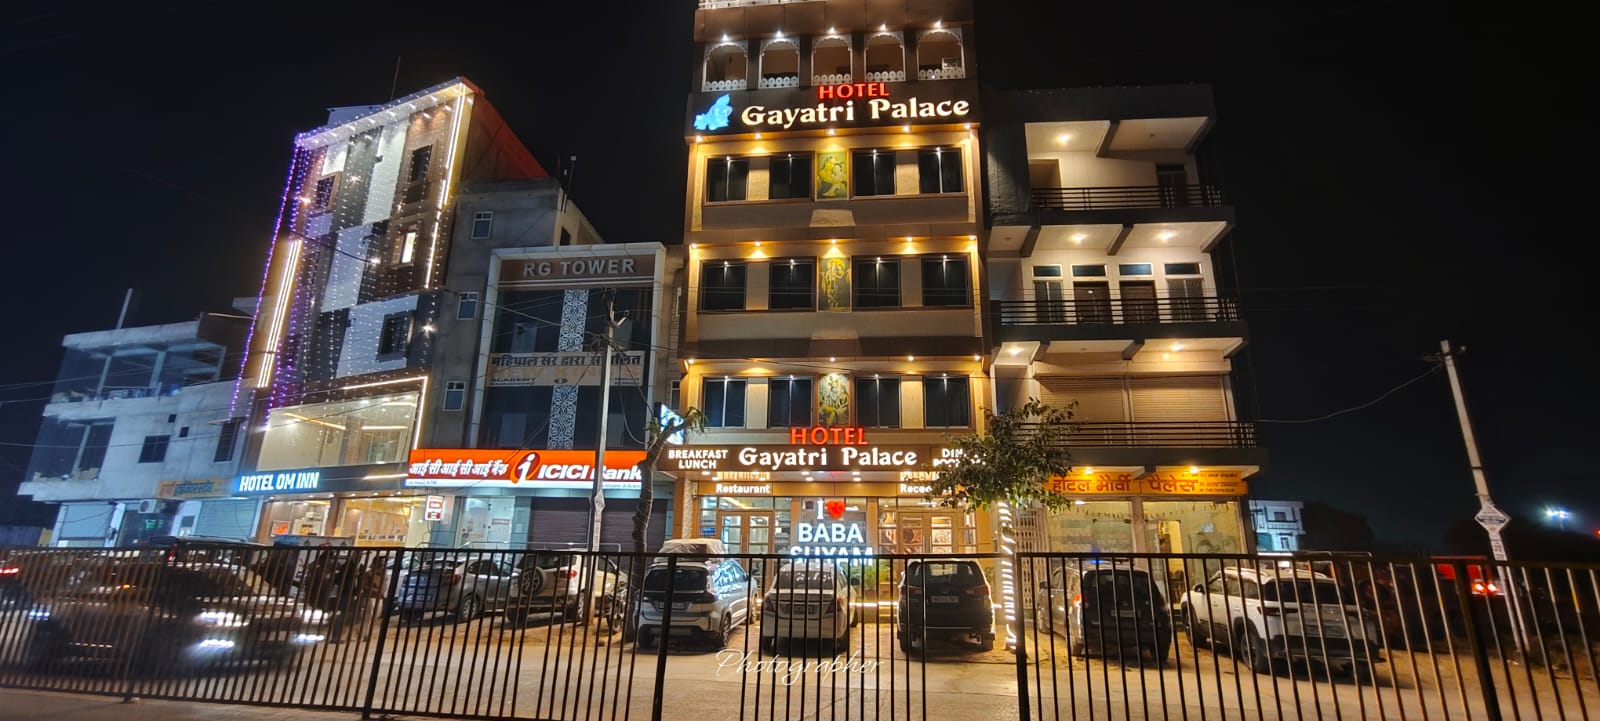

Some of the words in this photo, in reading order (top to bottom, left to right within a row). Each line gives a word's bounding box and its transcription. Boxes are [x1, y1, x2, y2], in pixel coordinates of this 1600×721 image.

[818, 82, 890, 99] HOTEL
[741, 100, 853, 129] Gayatri
[868, 97, 970, 119] Palace
[523, 262, 551, 277] RG
[561, 258, 635, 275] TOWER
[790, 426, 868, 446] HOTEL
[668, 449, 728, 460] BREAKFAST
[739, 447, 828, 471] Gayatri
[841, 447, 918, 466] Palace
[537, 464, 590, 479] ICICI
[678, 459, 717, 470] LUNCH
[239, 475, 274, 492] HOTEL
[276, 473, 296, 490] OM
[296, 472, 320, 488] INN
[716, 483, 770, 494] Restaurant
[1053, 474, 1093, 495] होटल
[1149, 474, 1199, 493] पैलेस
[798, 522, 864, 543] BABA
